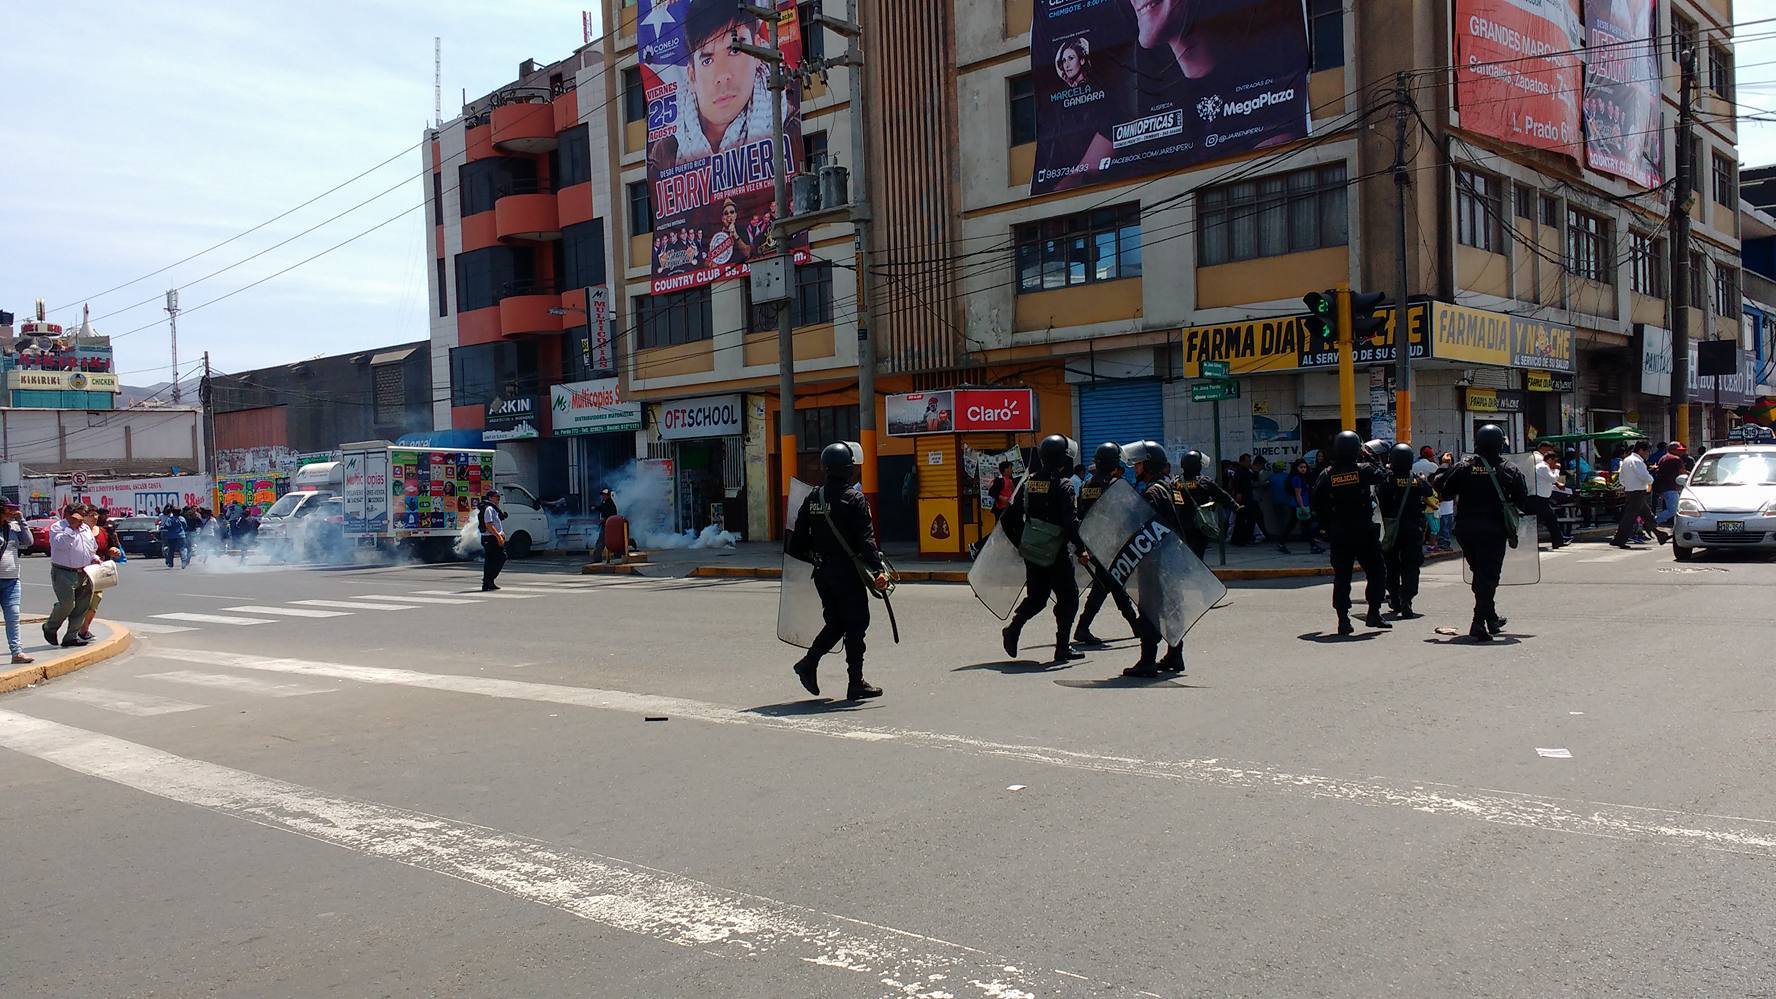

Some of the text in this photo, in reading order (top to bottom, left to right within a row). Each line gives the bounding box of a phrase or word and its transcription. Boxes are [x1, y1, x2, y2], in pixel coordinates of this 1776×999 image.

[1048, 4, 1082, 18] CHIMBOTE
[653, 37, 680, 53] CONEJO
[1469, 15, 1562, 66] GRANDES MARCAS
[646, 82, 678, 100] VIERNES
[1235, 80, 1264, 92] ENTRADAS
[1515, 71, 1549, 93] Zapatos
[1050, 84, 1091, 102] MARCELA
[1063, 91, 1105, 108] GANDARA
[1223, 88, 1294, 117] MegaPlaza
[648, 94, 678, 130] 25
[648, 125, 677, 142] AGOSTO
[1116, 113, 1174, 140] OMNIOPTICAS
[1525, 116, 1559, 140] Prado
[660, 158, 706, 178] DESDE PUERTO RICO
[655, 166, 711, 219] JERRY
[713, 191, 724, 200] POR
[724, 186, 745, 199] PRIMERA
[746, 184, 756, 193] VEZ
[756, 182, 764, 190] EN
[654, 273, 695, 292] COUNTRY
[696, 268, 721, 283] CLUB
[1186, 324, 1255, 363] FARMA
[1260, 320, 1297, 356] DIA
[1515, 322, 1524, 353] Y
[16, 352, 111, 370] KIKIRIKI
[1302, 345, 1424, 366] AL SERVO DE SU SUD
[1514, 355, 1570, 370] AL SERVICIO DE SU SALUD
[20, 375, 115, 387] KIKIRIKI CHICKEN
[571, 385, 613, 410] Multicopias
[664, 404, 739, 430] OFISCHOOL
[967, 405, 1012, 422] Claro
[1332, 474, 1358, 484] POLICIA
[1110, 520, 1172, 587] POLICIA
